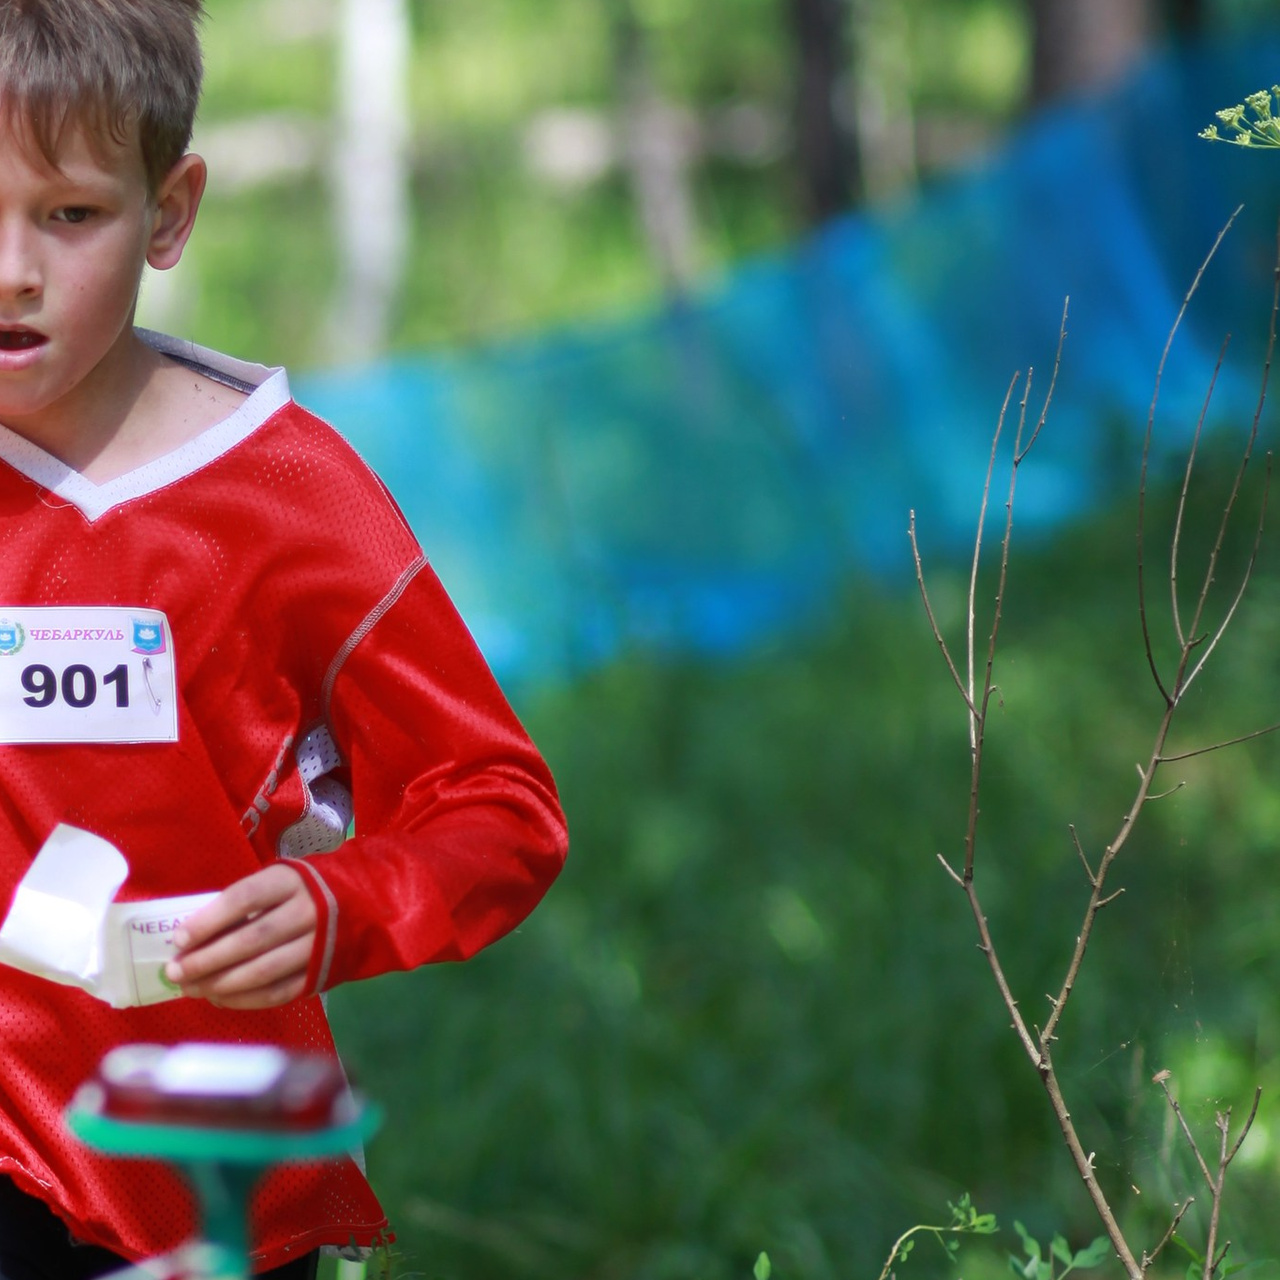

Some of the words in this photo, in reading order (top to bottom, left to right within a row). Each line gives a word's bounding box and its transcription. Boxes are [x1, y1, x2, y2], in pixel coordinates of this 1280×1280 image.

[29, 629, 125, 641] ЧЕБАРКУЛЬ
[21, 663, 129, 708] 901
[131, 916, 187, 934] ЧЕБА
